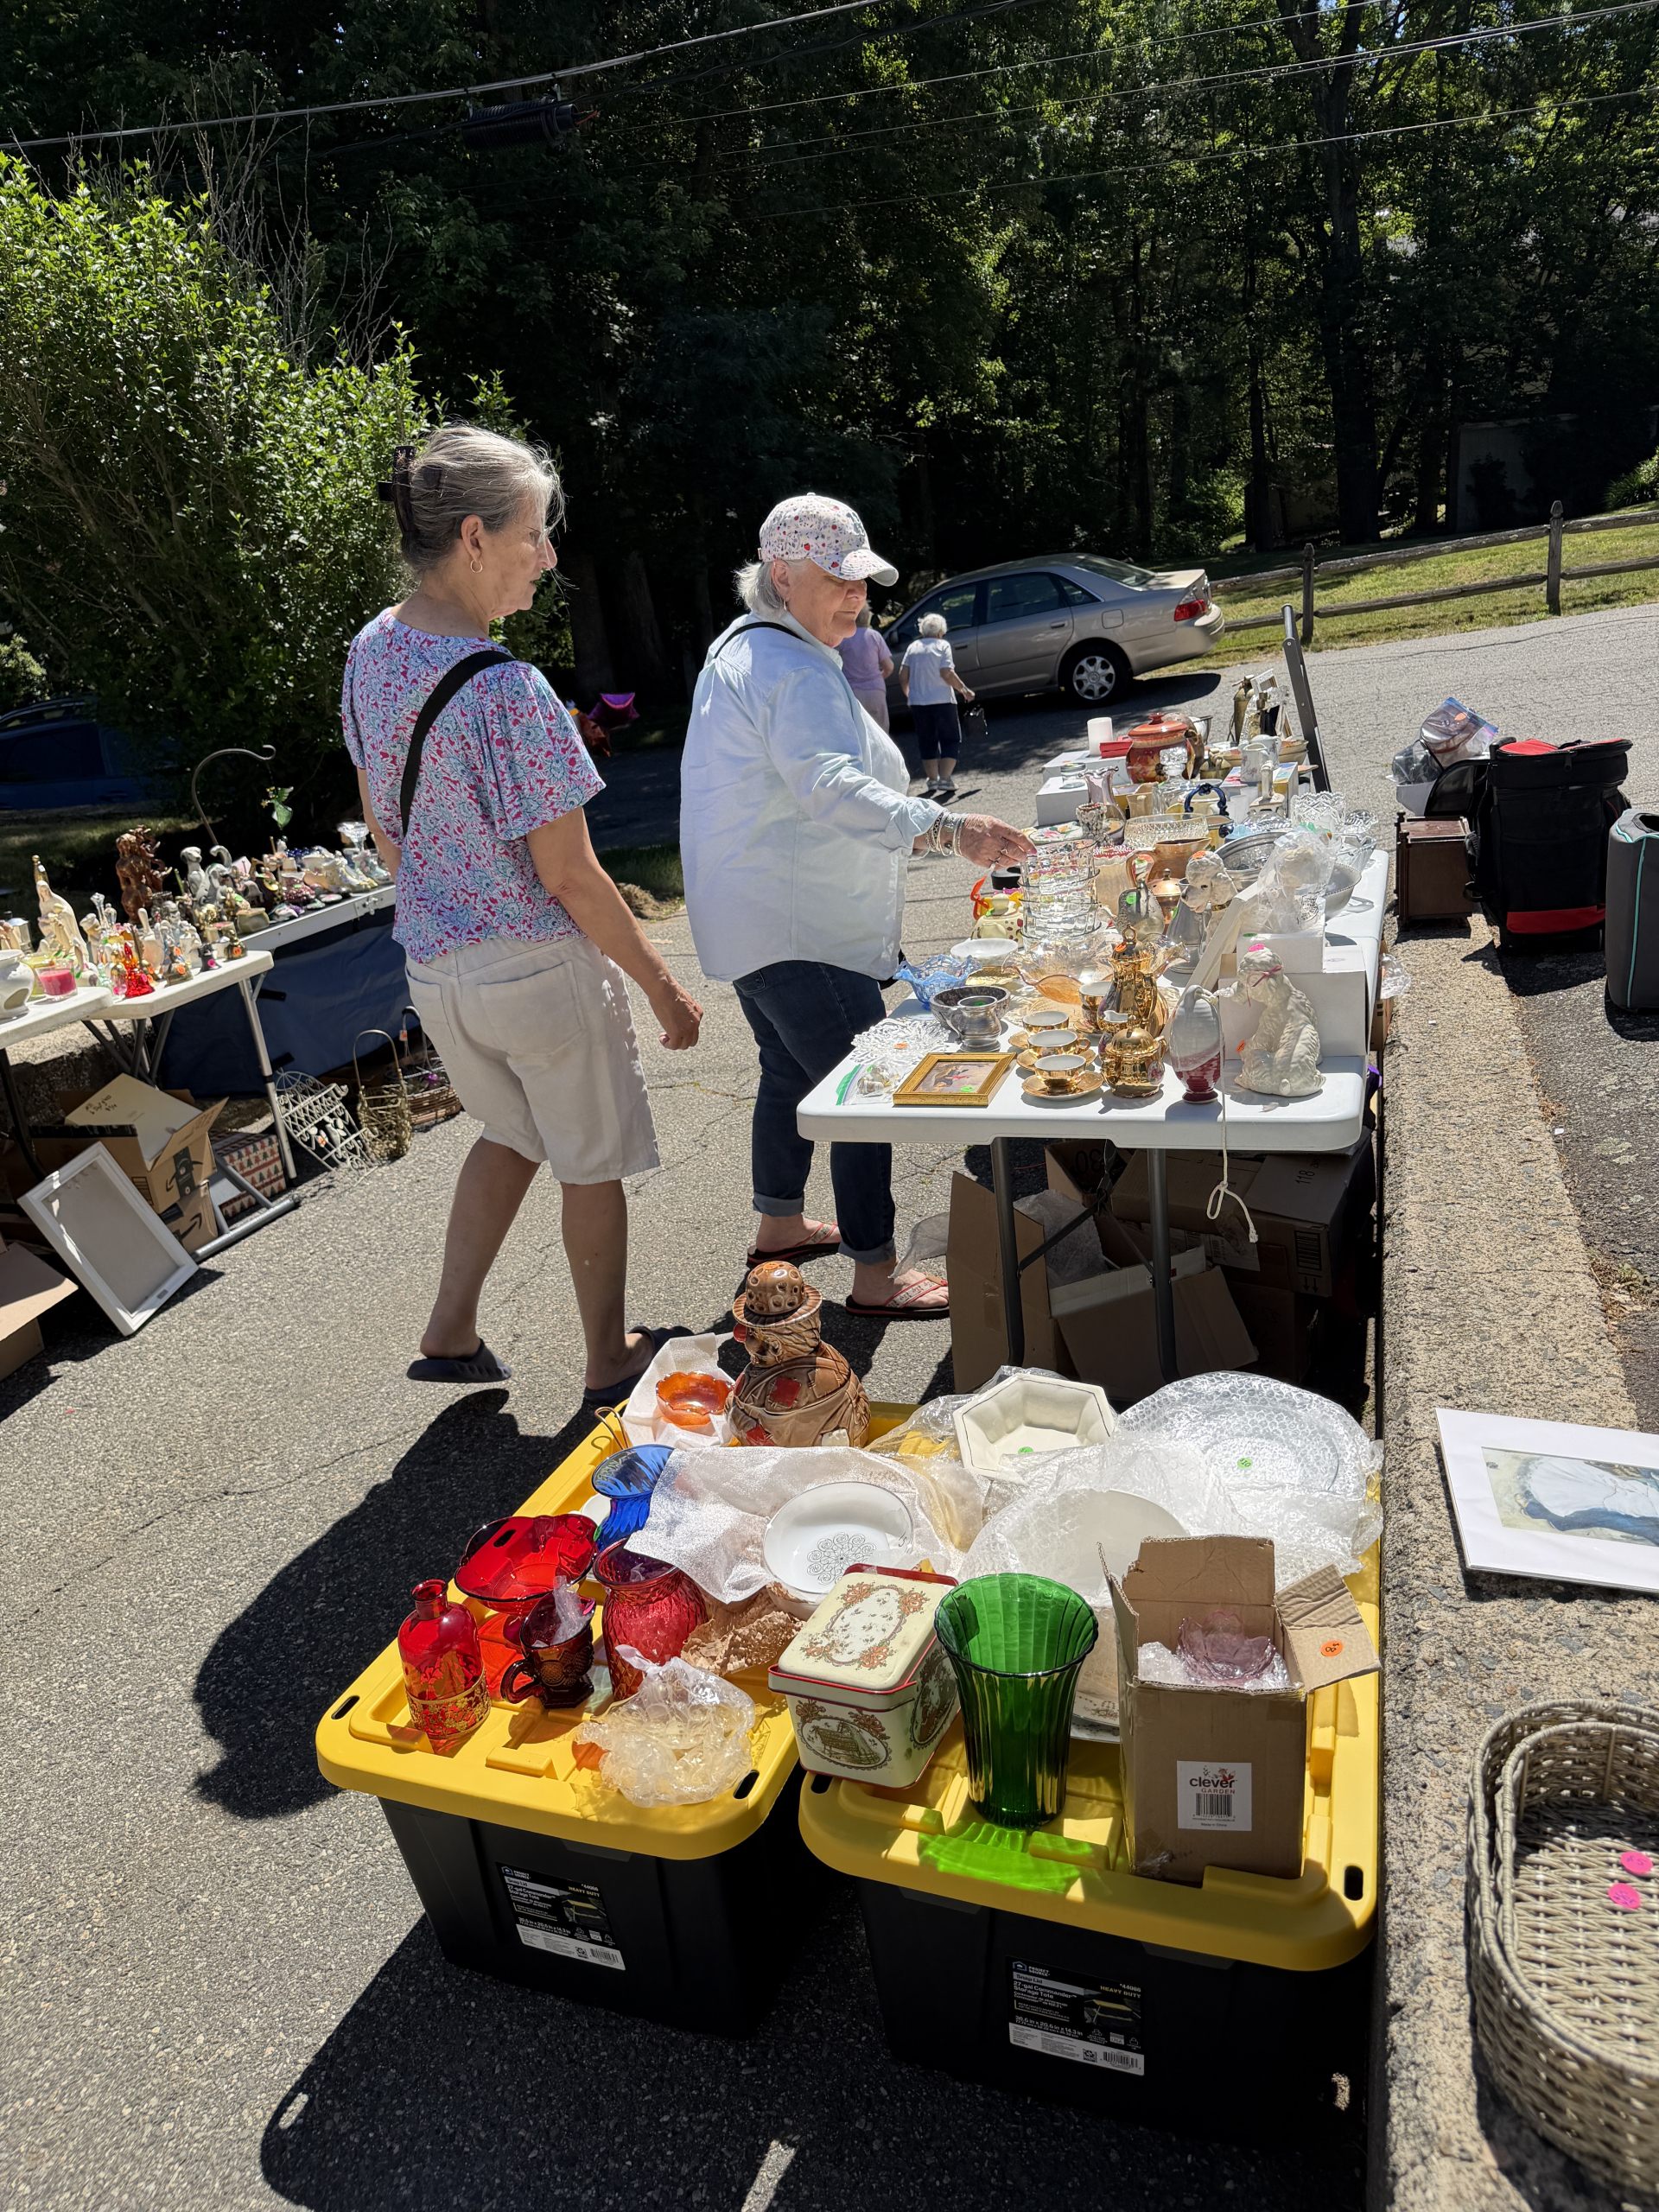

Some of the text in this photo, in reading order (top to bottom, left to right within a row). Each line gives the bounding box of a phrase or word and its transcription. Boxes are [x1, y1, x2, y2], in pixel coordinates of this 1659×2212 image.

[1295, 1170, 1315, 1184] 118
[1239, 1458, 1251, 1467] $10
[1190, 1777, 1235, 1788] clever
[1014, 1980, 1033, 1989] 27-gal
[1014, 1986, 1039, 1995] Storage
[1100, 1985, 1122, 1994] HEAVY
